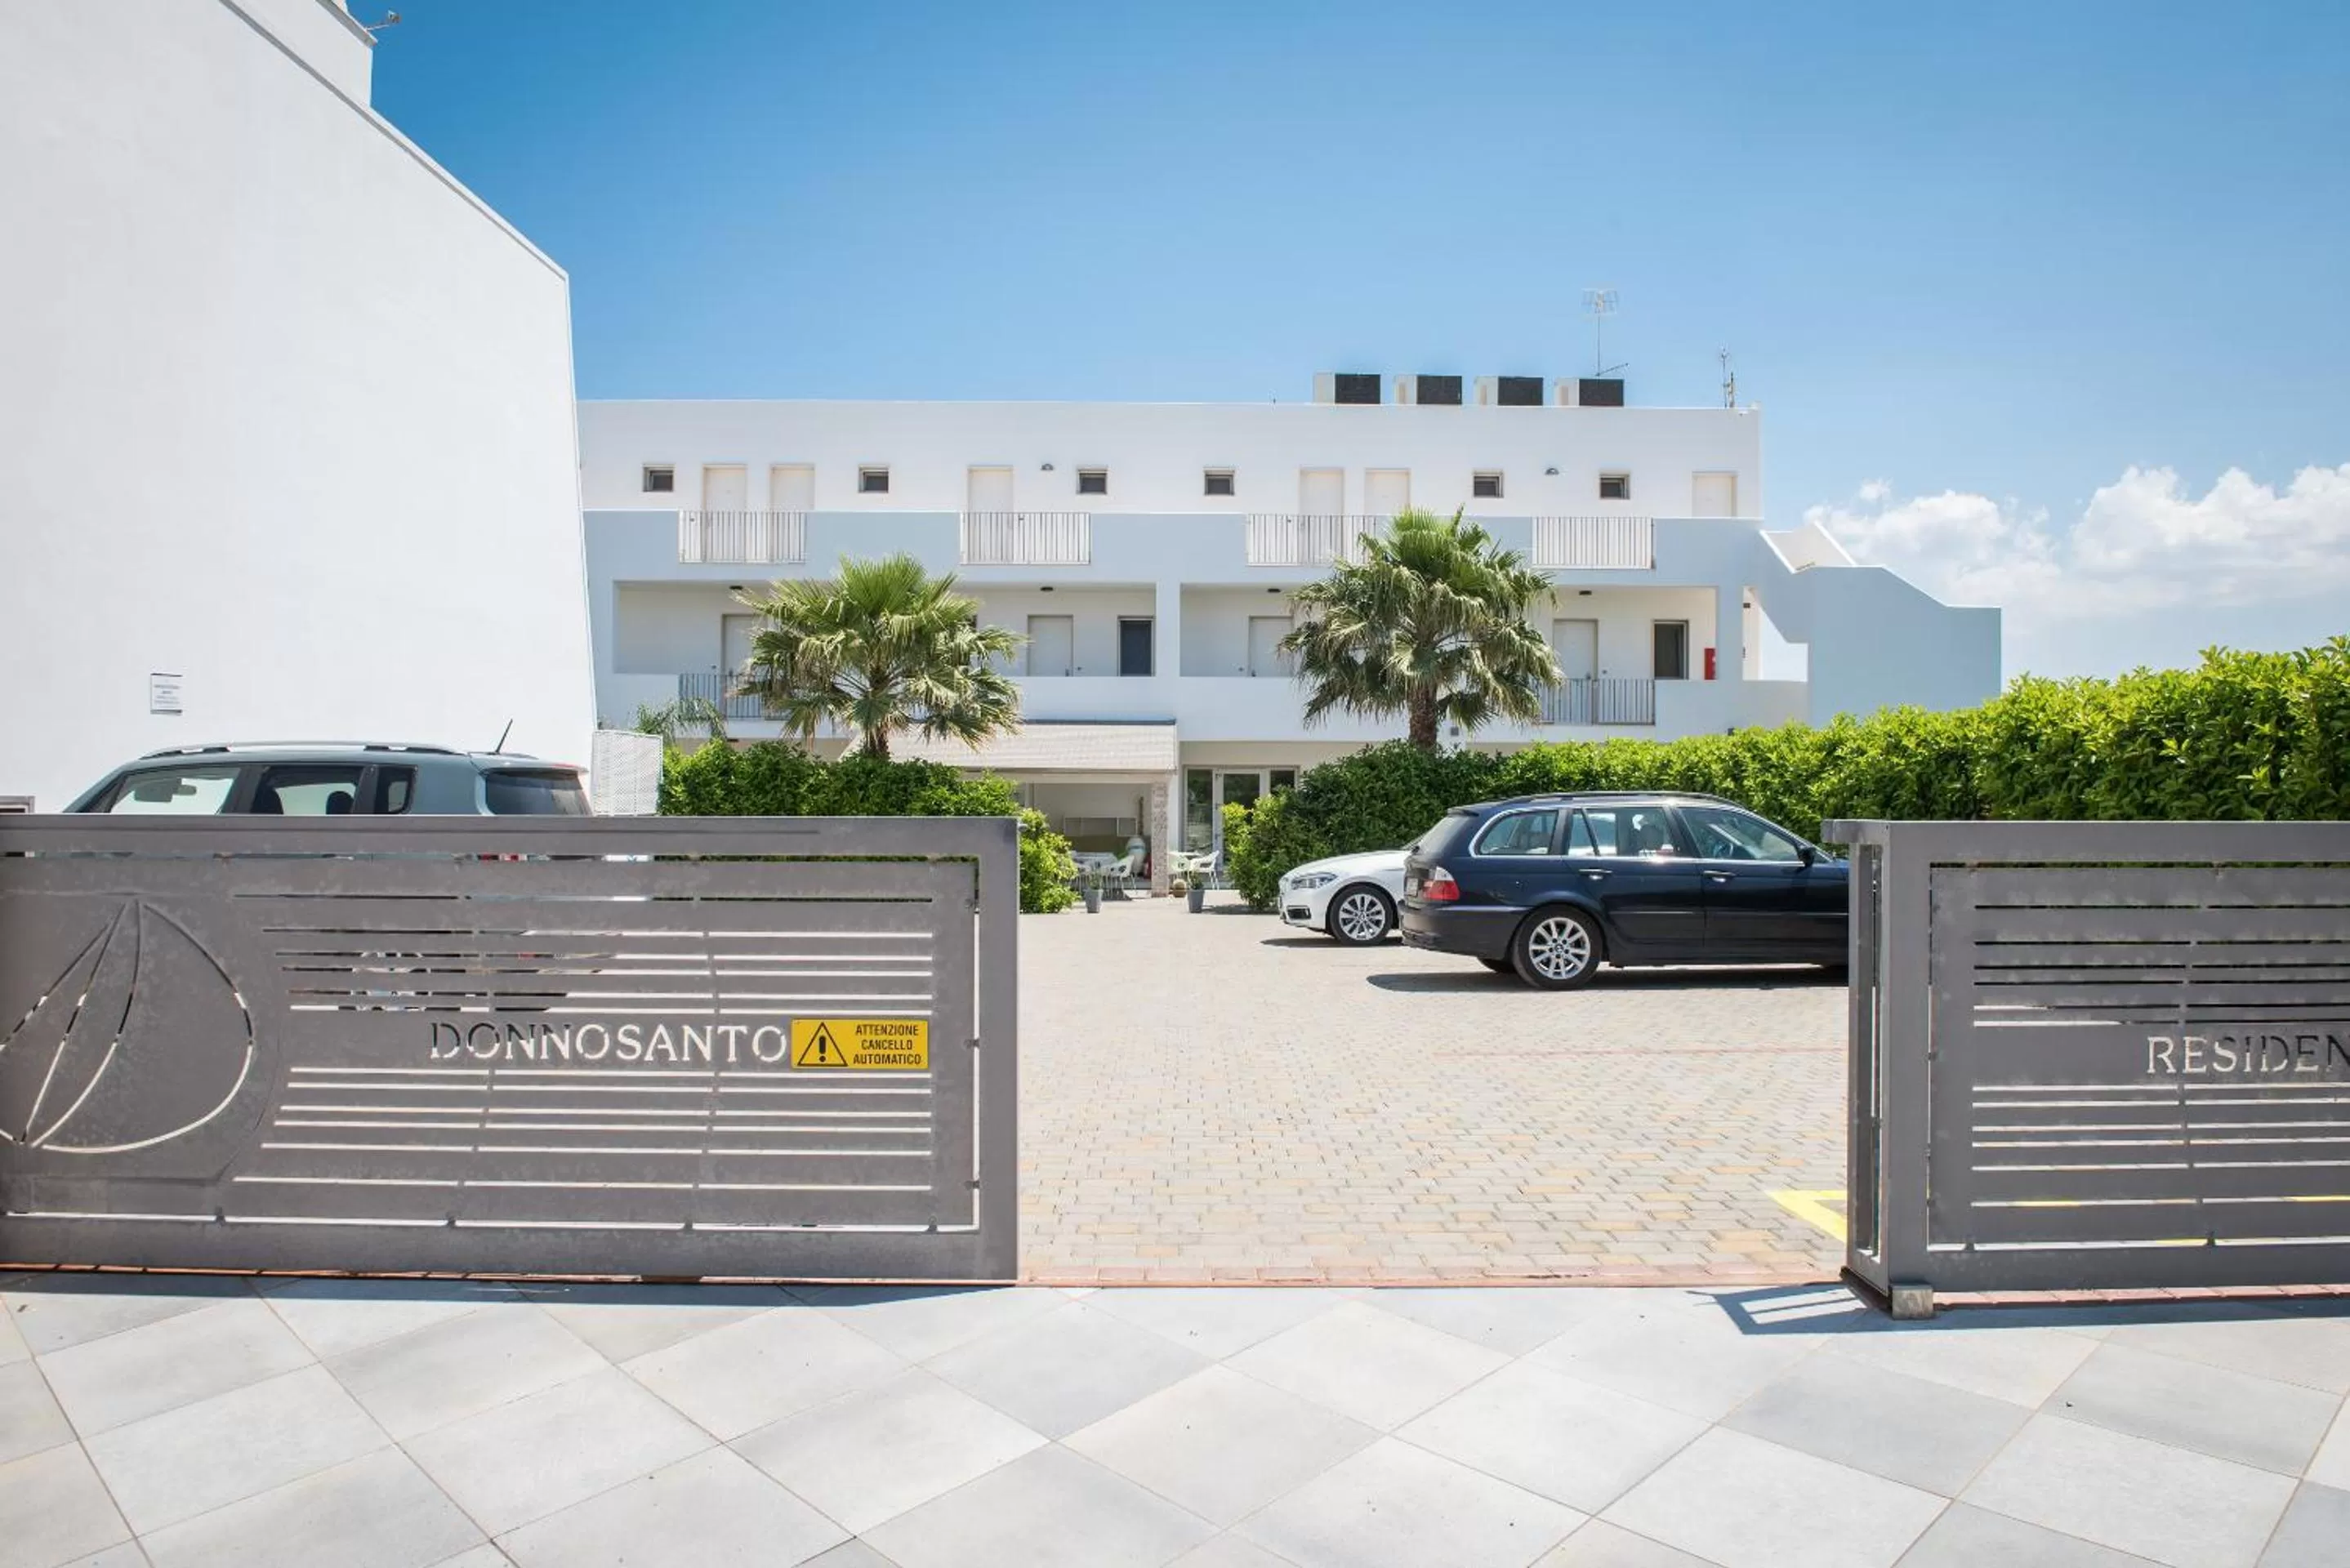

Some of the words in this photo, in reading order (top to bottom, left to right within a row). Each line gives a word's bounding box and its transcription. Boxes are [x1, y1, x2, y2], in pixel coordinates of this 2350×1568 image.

[855, 1024, 919, 1036] ATTENZIONE
[430, 1022, 787, 1062] DONNOSANTO
[861, 1039, 912, 1050] CANCELLO
[853, 1054, 922, 1065] AUTOMATICO
[2147, 1035, 2350, 1074] RESIDEN
